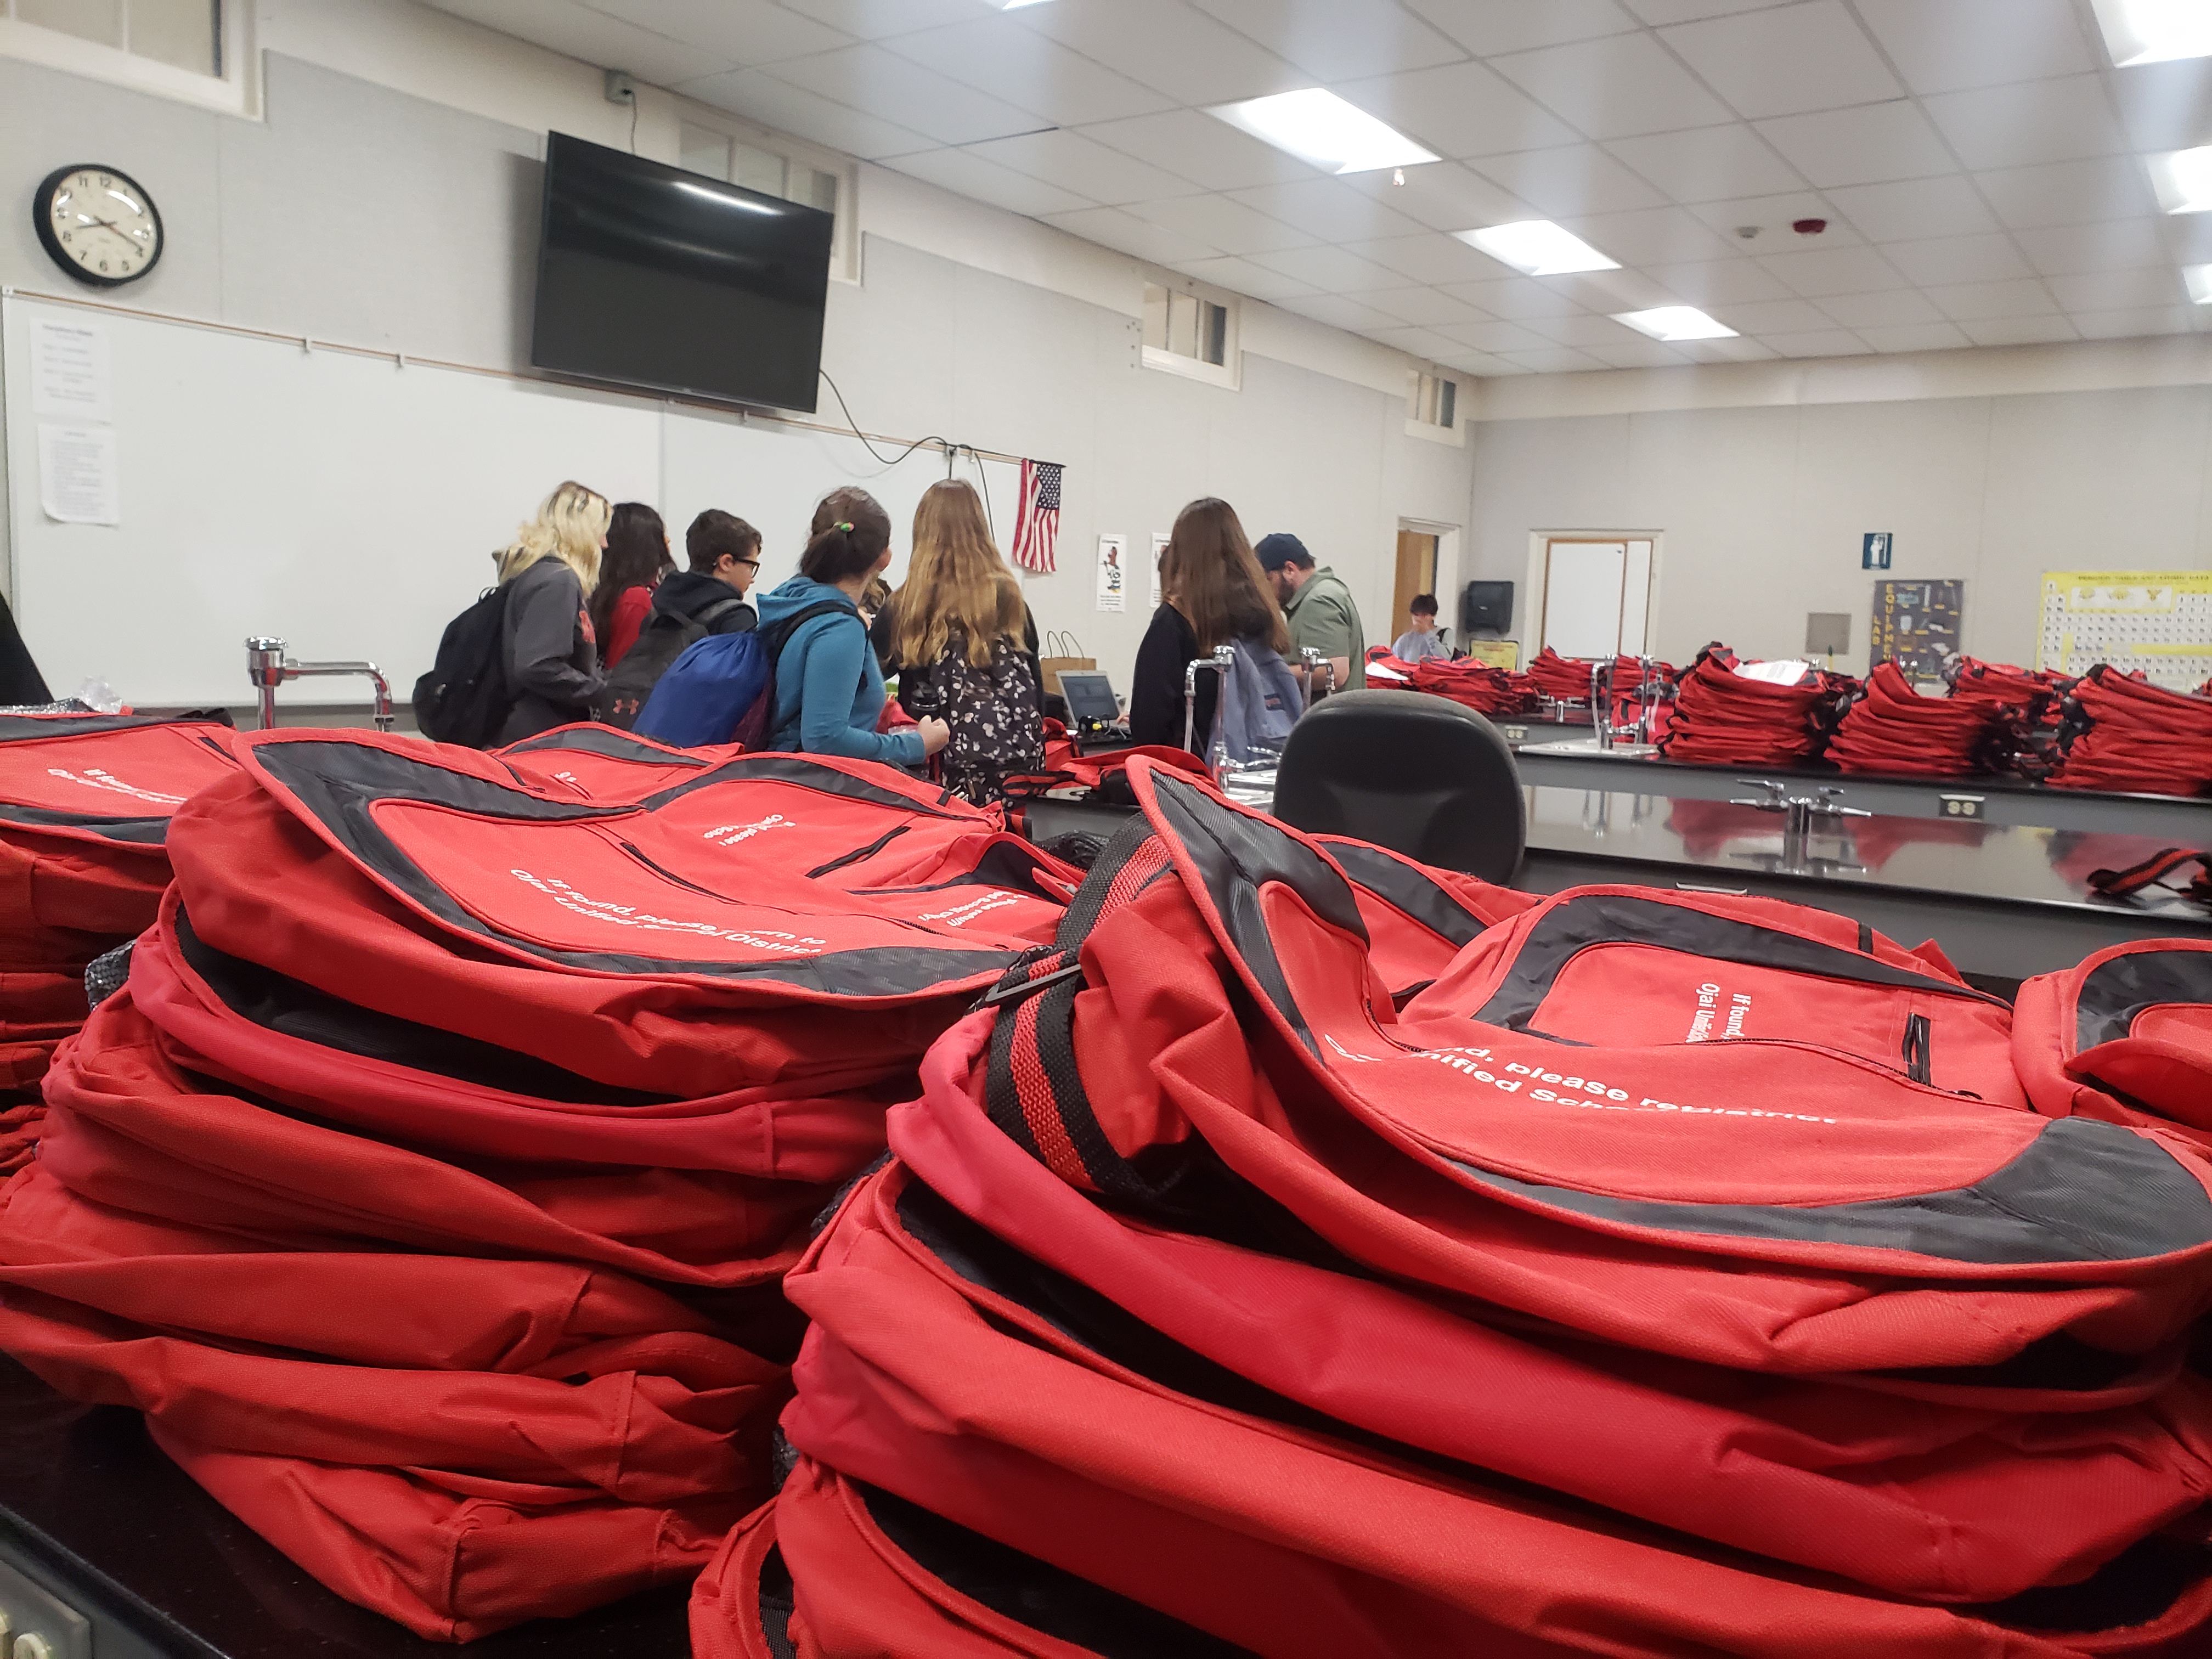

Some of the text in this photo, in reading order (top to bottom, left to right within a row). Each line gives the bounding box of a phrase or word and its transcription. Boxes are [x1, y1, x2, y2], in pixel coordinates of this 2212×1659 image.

[100, 173, 111, 188] 12
[63, 230, 72, 242] 8
[80, 250, 87, 261] 7
[100, 259, 108, 272] 6
[121, 260, 129, 272] 5
[1872, 615, 1881, 645] LAB
[1883, 583, 1894, 660] EQUIPMEN
[546, 878, 572, 890] If
[564, 890, 637, 916] found,
[799, 936, 827, 945] to
[1696, 983, 1720, 1008] Ojai
[1720, 993, 1752, 1037] If found,
[1504, 1062, 1629, 1102] please
